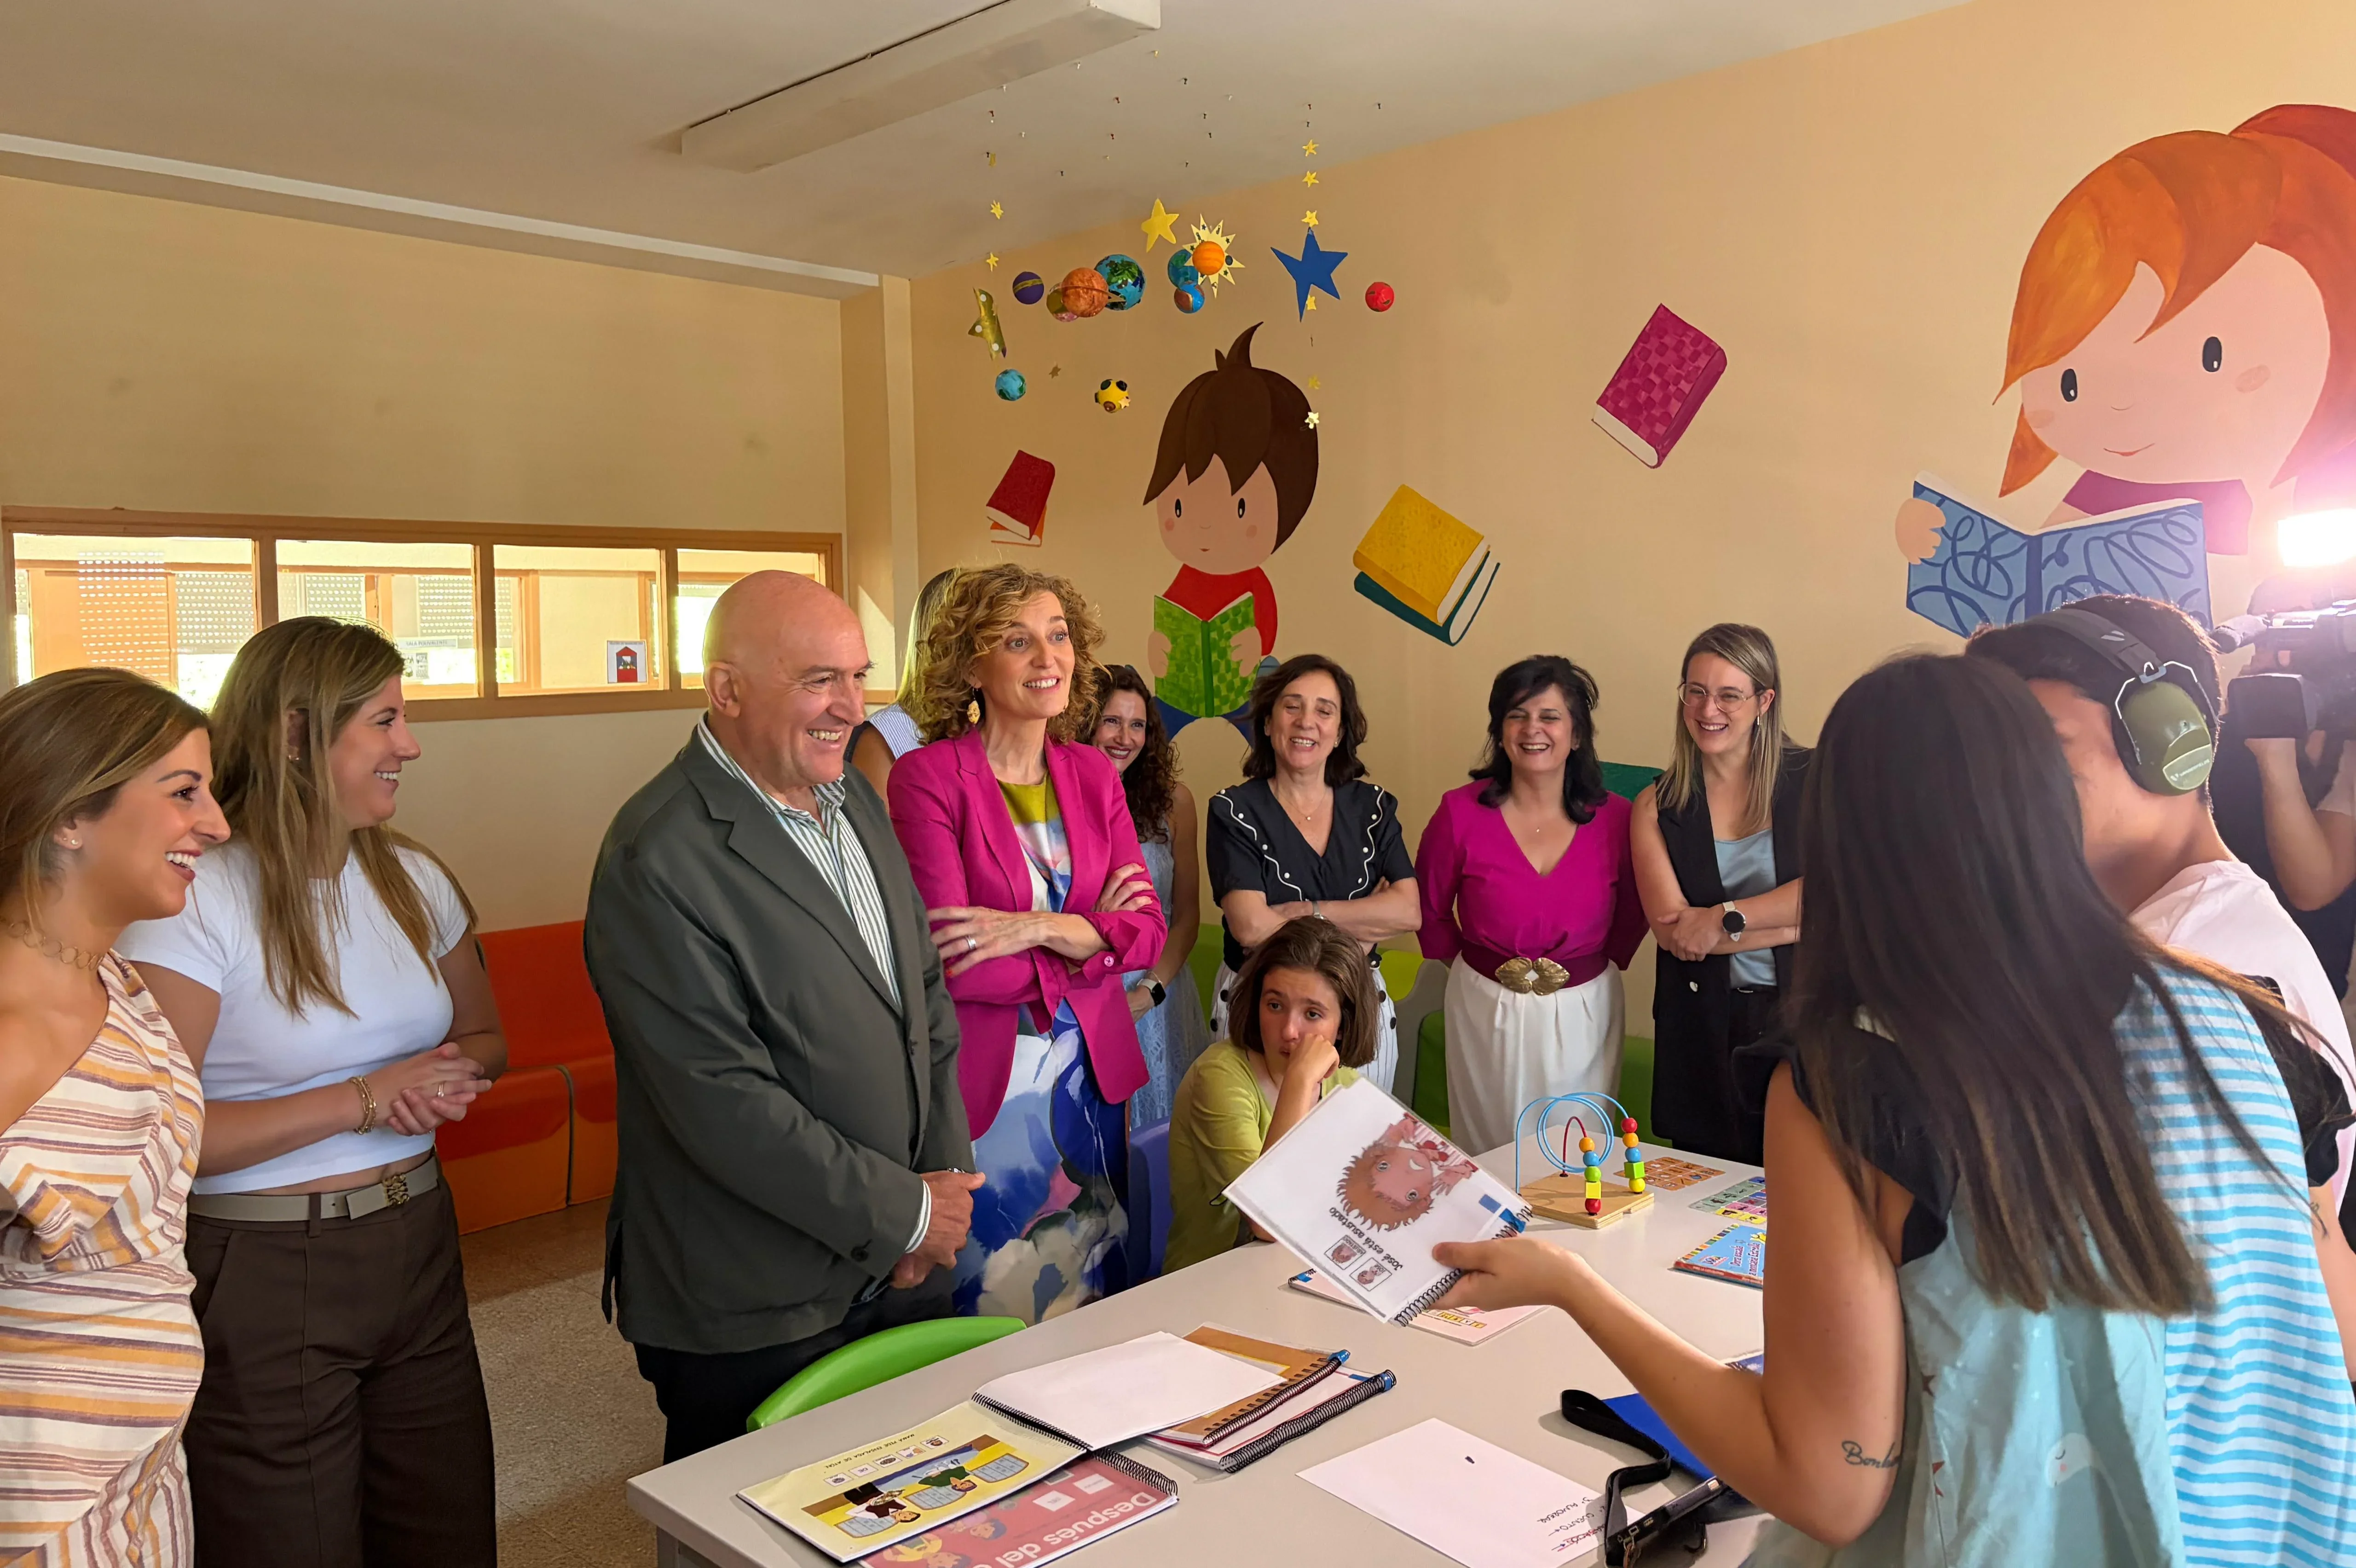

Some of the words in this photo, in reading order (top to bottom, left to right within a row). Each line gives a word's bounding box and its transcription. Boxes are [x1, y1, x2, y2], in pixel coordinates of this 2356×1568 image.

[1329, 1207, 1365, 1239] asustado
[1363, 1237, 1384, 1254] está
[1381, 1254, 1403, 1271] José
[1043, 1492, 1157, 1541] Después
[1559, 1513, 1594, 1530] CUENTO
[995, 1542, 1041, 1568] del
